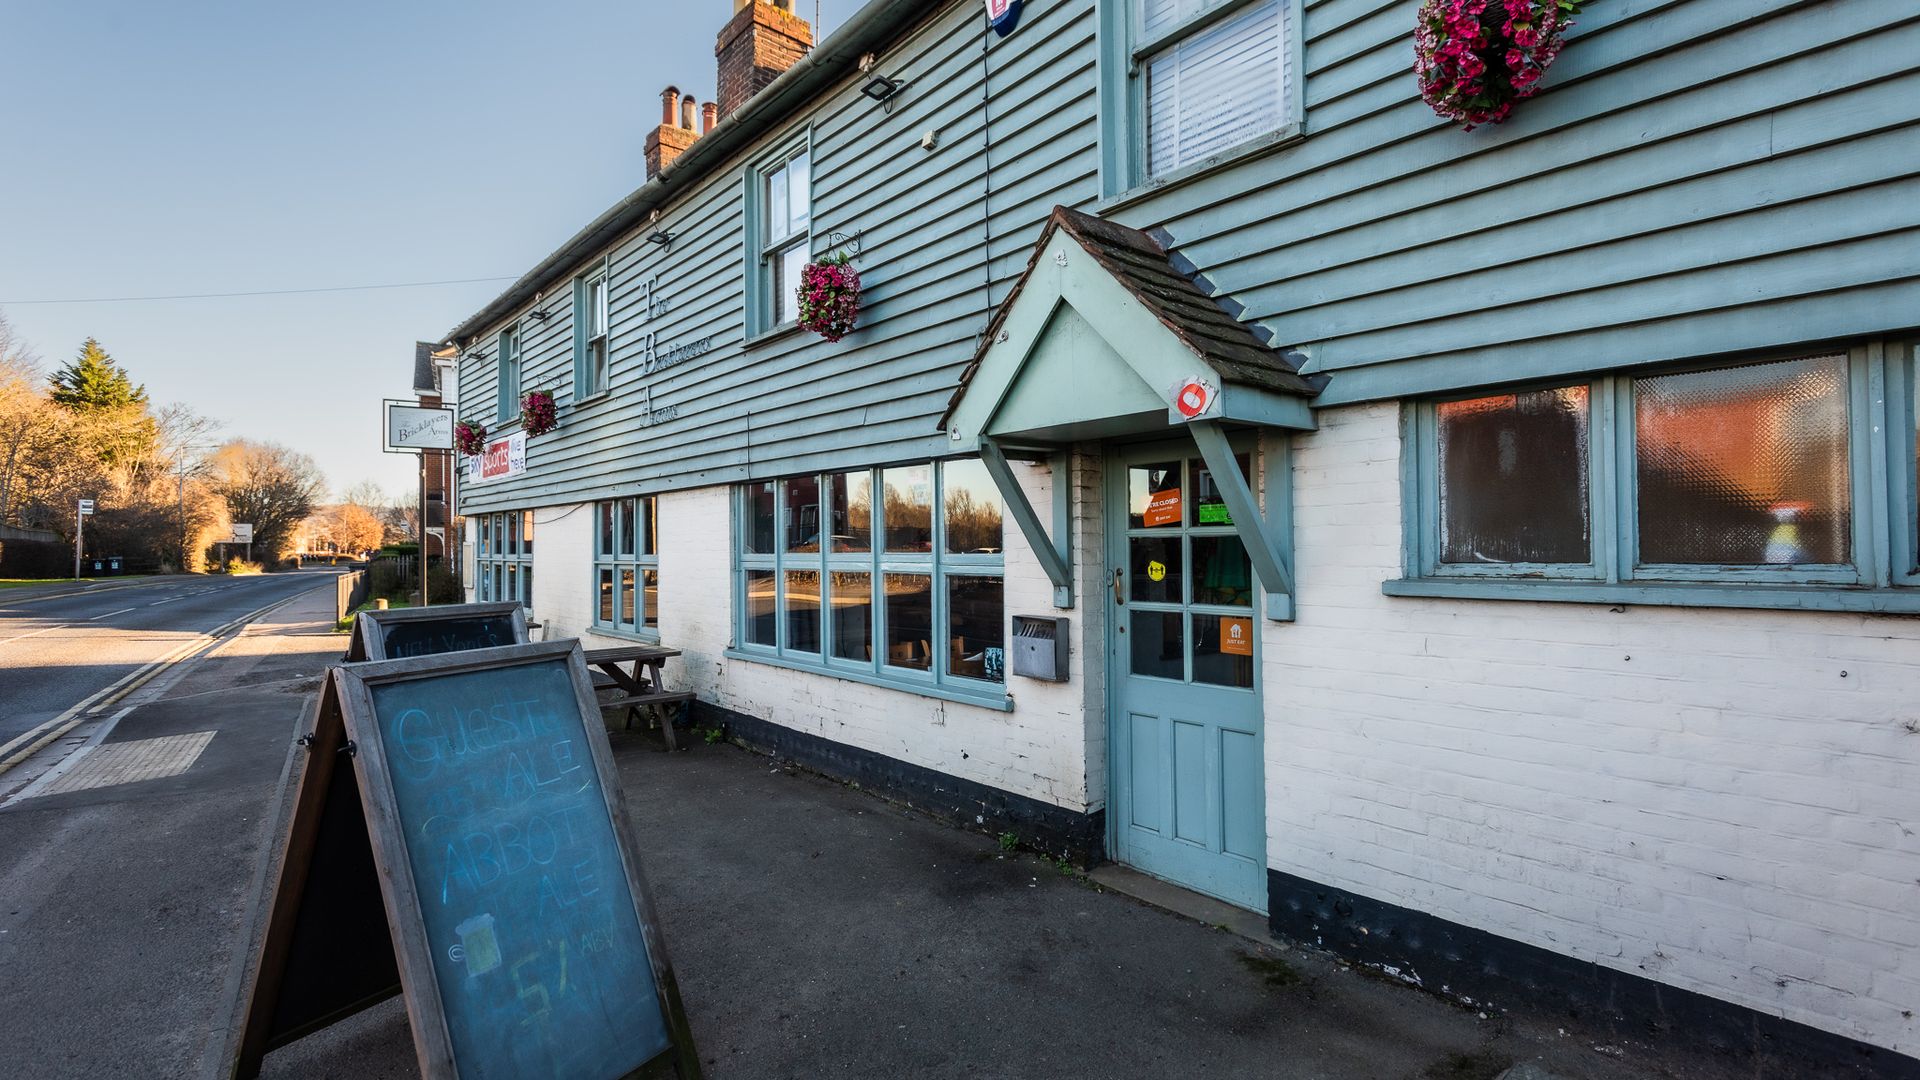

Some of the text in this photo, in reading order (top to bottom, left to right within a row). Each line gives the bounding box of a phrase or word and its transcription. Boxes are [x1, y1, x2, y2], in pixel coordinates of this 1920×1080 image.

[398, 414, 449, 442] Bricklayers
[484, 446, 508, 474] sports
[1159, 497, 1178, 506] CLOSED
[504, 739, 582, 798] ALE
[442, 803, 584, 905] ABBOT
[539, 859, 600, 917] ALE
